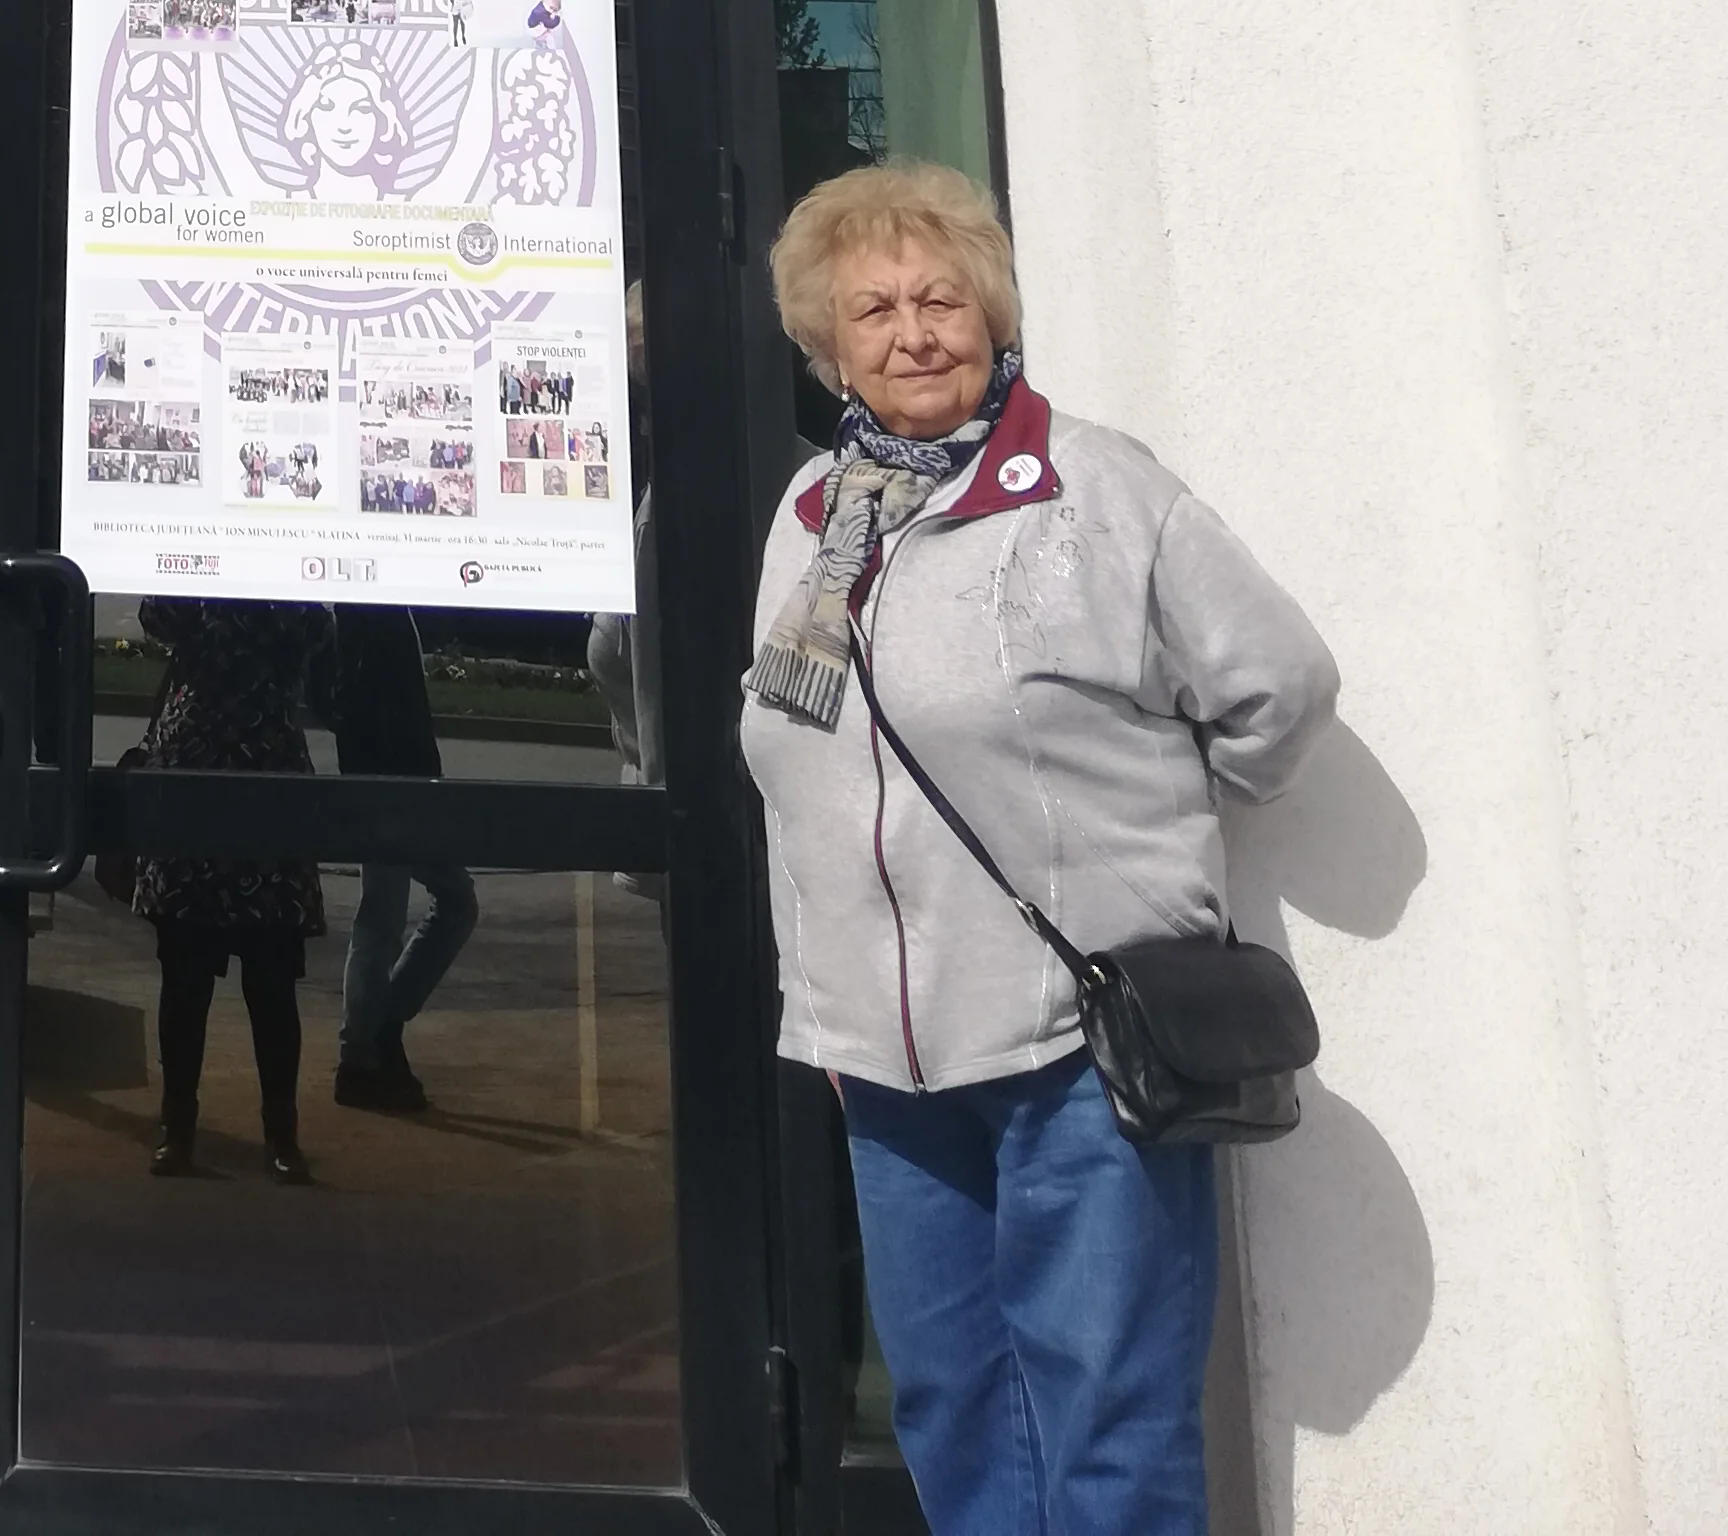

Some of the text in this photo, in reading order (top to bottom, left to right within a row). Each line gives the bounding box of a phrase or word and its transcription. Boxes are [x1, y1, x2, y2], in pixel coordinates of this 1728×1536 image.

[84, 201, 246, 228] a global voice
[176, 225, 264, 243] for women
[353, 230, 613, 255] Soroptimist International
[256, 266, 448, 283] o voce universală pentru femei
[516, 345, 540, 357] STOP
[93, 521, 155, 534] BIBLIOTECA
[319, 529, 360, 541] SLATINA
[157, 557, 220, 570] FOTO FUJI
